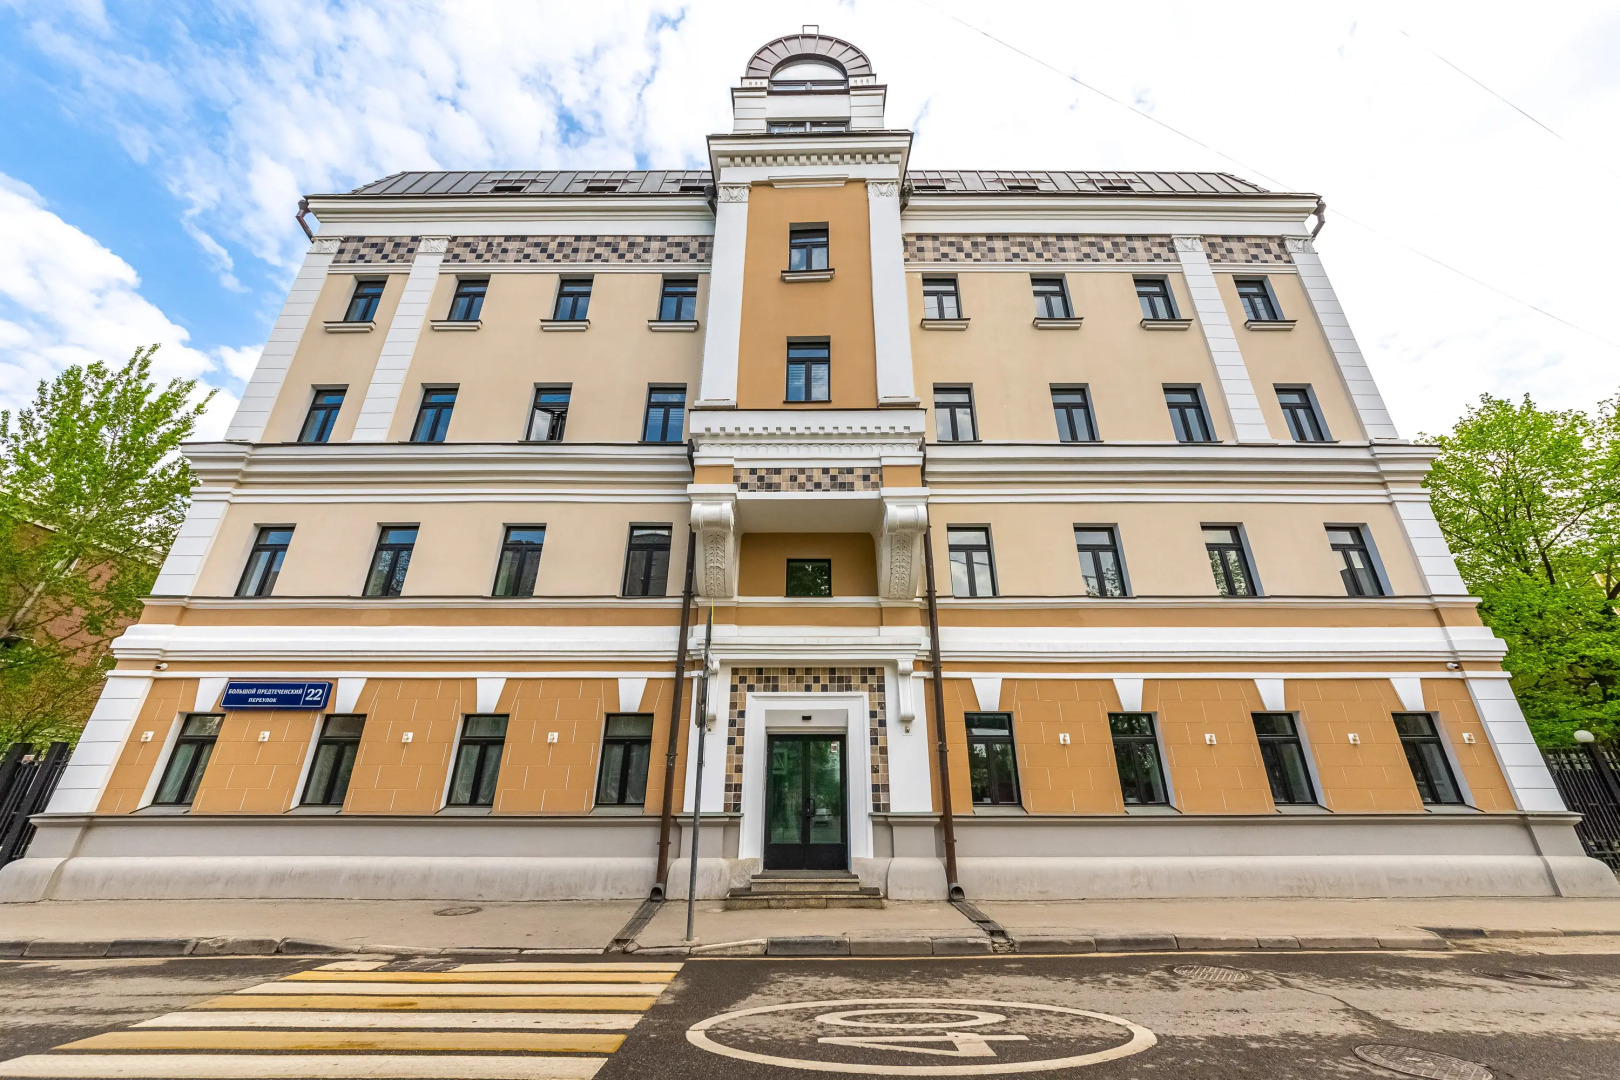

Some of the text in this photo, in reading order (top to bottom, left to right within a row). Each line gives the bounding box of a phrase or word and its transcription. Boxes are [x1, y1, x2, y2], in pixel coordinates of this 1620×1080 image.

[228, 687, 256, 695] БОЛЬШОЙ
[305, 688, 323, 701] 22
[814, 1008, 1029, 1057] 40
